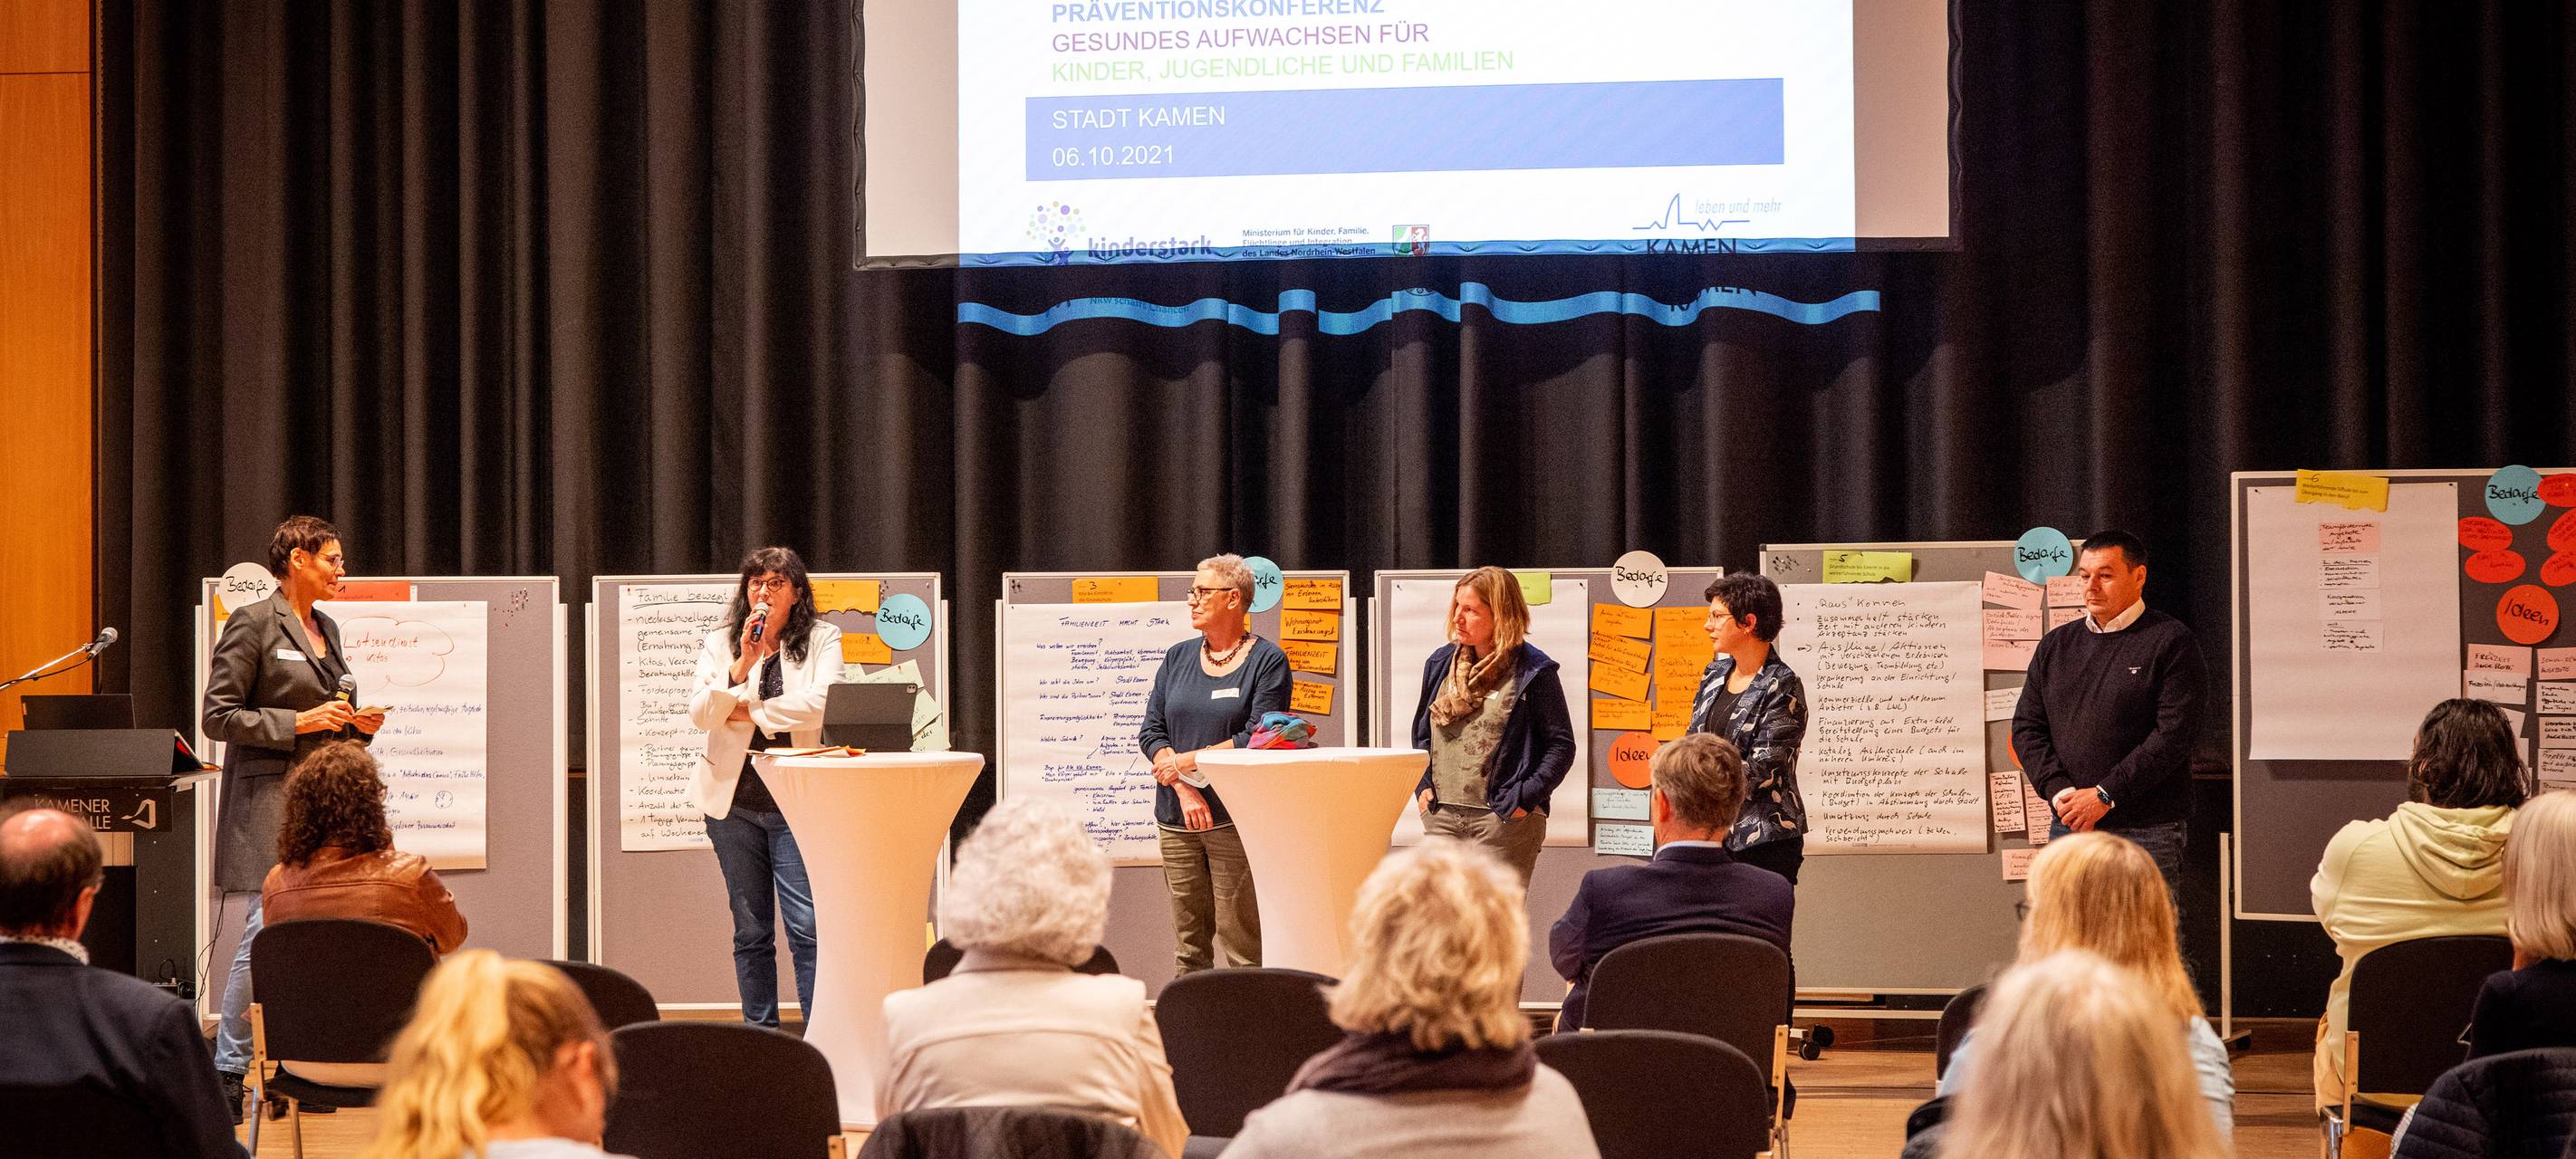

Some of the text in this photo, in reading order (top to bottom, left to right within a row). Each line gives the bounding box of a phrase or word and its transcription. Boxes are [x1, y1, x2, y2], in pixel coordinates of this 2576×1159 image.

[1053, 21, 1428, 53] GESUNDES AUFWACHSEN FÜR
[1053, 51, 1514, 82] KINDER, JUGENDLICHE UND FAMILIEN
[1053, 106, 1226, 129] STADT KAMEN
[1053, 145, 1173, 167] 06.10.2021
[1695, 198, 1782, 215] leben und mehr
[1088, 236, 1212, 257] kinderstark
[1647, 239, 1736, 254] KAMEN
[2312, 474, 2321, 482] 6
[2488, 484, 2540, 504] Bedarfe
[1839, 554, 1848, 562] 5
[2018, 546, 2068, 562] Bedarfe
[1089, 581, 1097, 589] 3
[635, 589, 678, 602] Familie
[1857, 598, 1906, 607] Kommen
[2504, 599, 2550, 626] Ideen
[879, 608, 925, 630] Bedarfe
[1908, 621, 1946, 629] Kindern
[638, 629, 692, 641] gemeinsame
[1890, 641, 1946, 651] Aktionen
[1816, 682, 1844, 690] Schule
[1836, 735, 1863, 743] Schule
[649, 772, 689, 782] Umsetzun
[1934, 768, 1967, 776] Schule
[1822, 777, 1838, 785] mit
[639, 786, 685, 795] Koordinatio
[35, 799, 111, 813] KAMENER
[1956, 797, 1980, 805] Stadt
